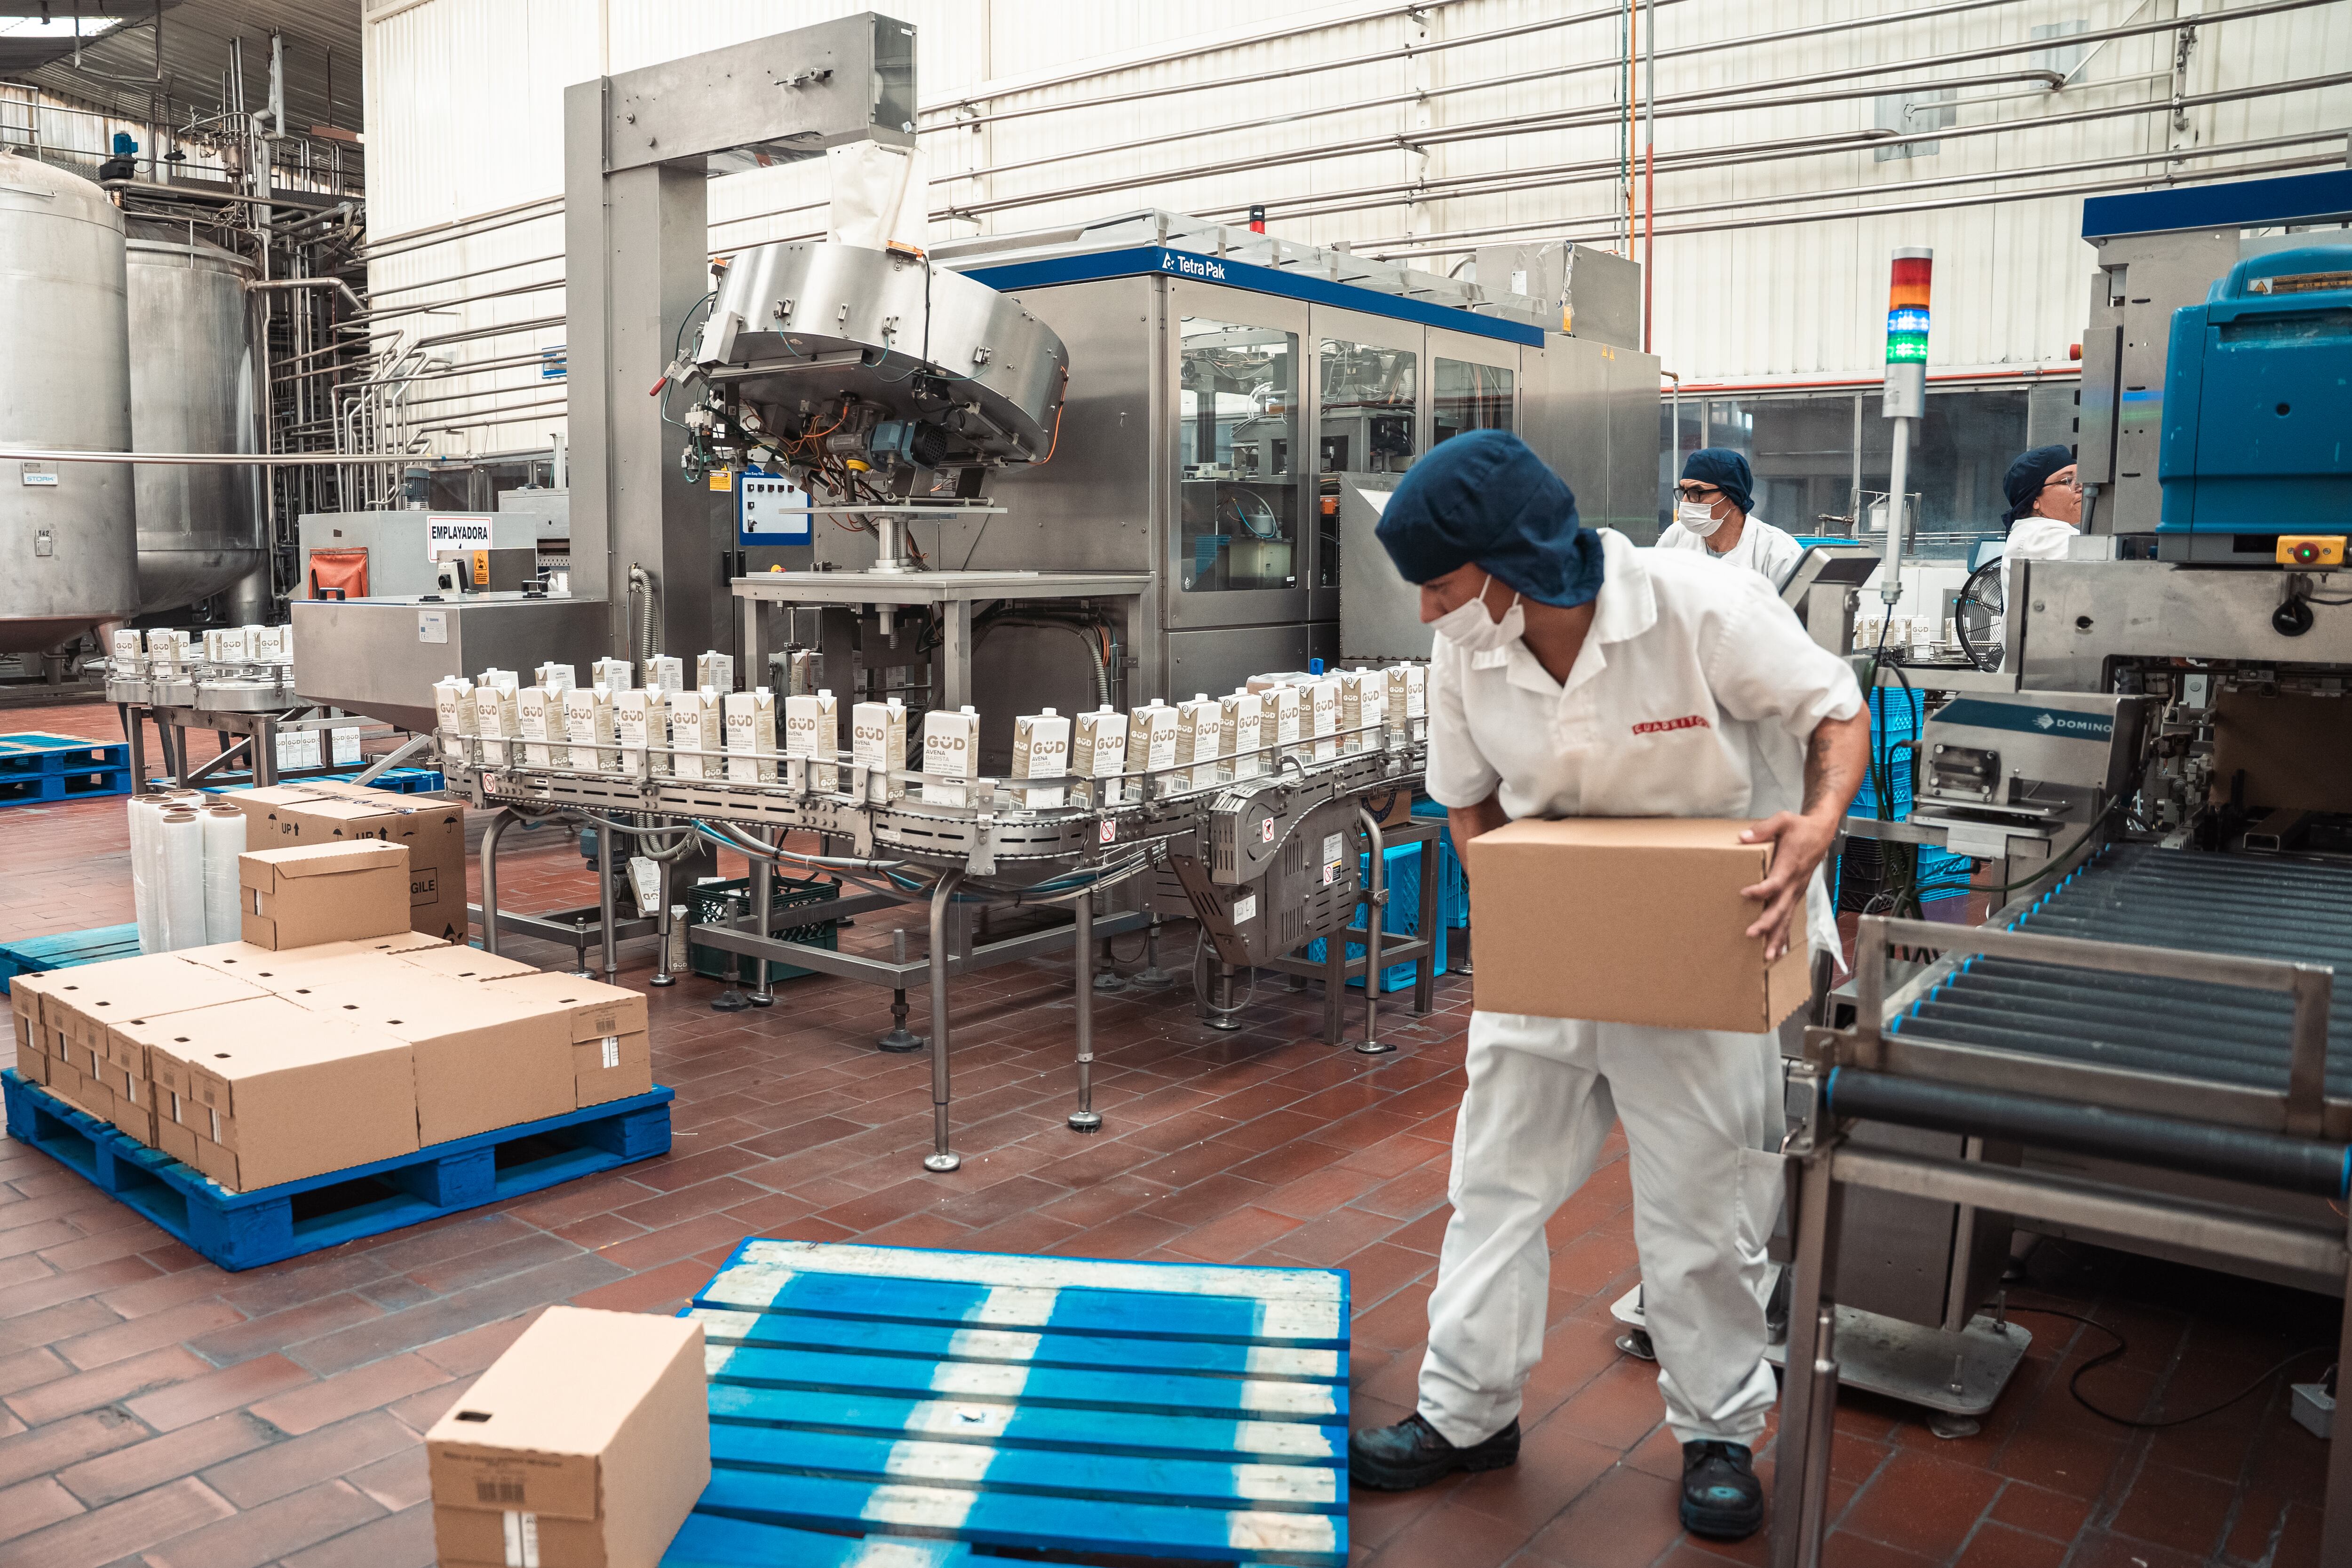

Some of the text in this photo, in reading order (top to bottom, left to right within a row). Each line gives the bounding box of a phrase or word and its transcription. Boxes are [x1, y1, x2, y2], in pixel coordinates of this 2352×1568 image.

[1177, 255, 1225, 279] Tetra Pak
[432, 526, 488, 540] EMPLAYADORA
[788, 717, 815, 731] GÜD
[1634, 716, 1711, 734] CUADRITO
[2057, 719, 2114, 732] DOMINO
[855, 726, 884, 741] GÜD
[927, 735, 965, 750] GÜD
[1033, 741, 1066, 755] GÜD
[282, 822, 292, 834] UP
[411, 879, 435, 894] GILE
